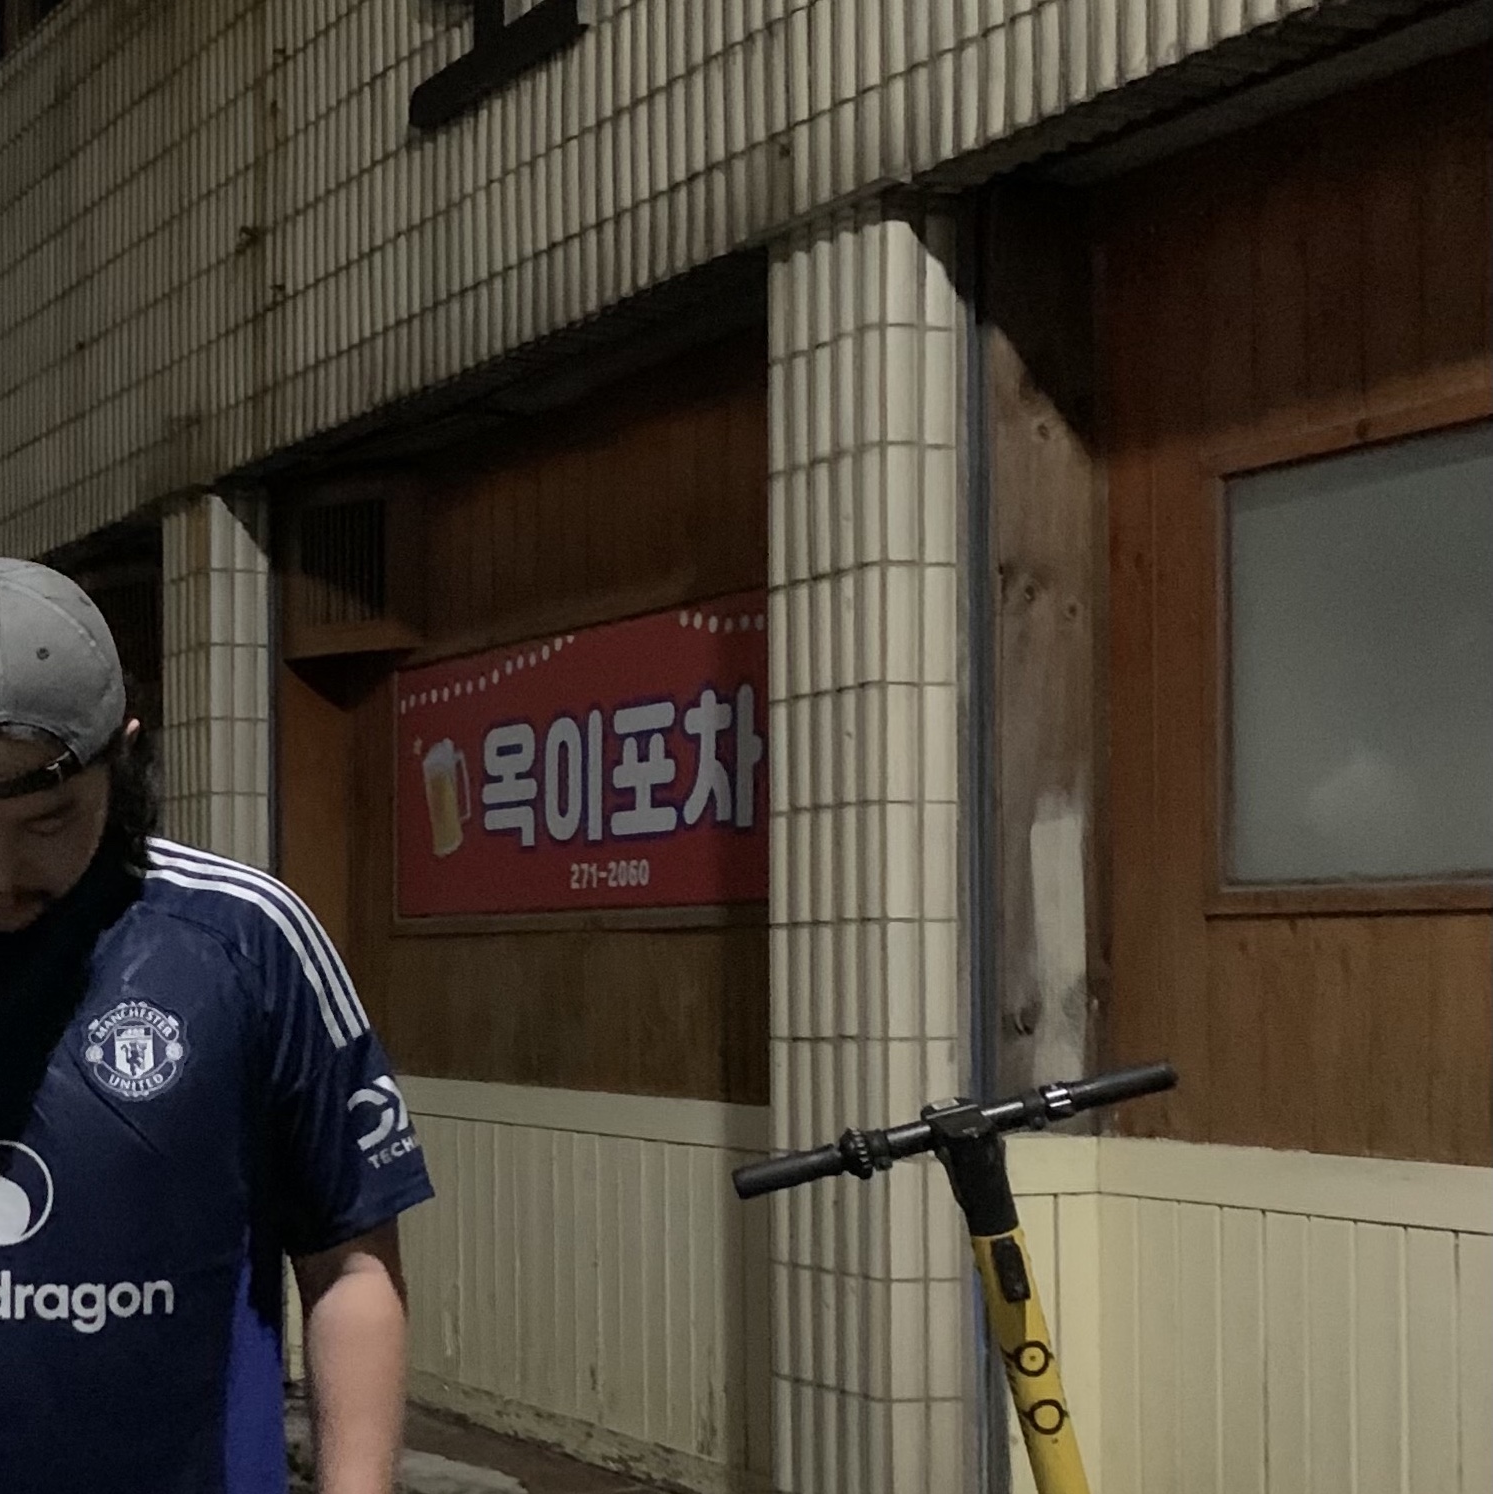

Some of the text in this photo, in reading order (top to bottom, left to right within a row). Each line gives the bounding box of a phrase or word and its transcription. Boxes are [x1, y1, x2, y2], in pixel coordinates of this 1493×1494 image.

[570, 858, 650, 889] 271-2060
[95, 1007, 173, 1040] MANCHESTER
[108, 1073, 164, 1092] UNITED
